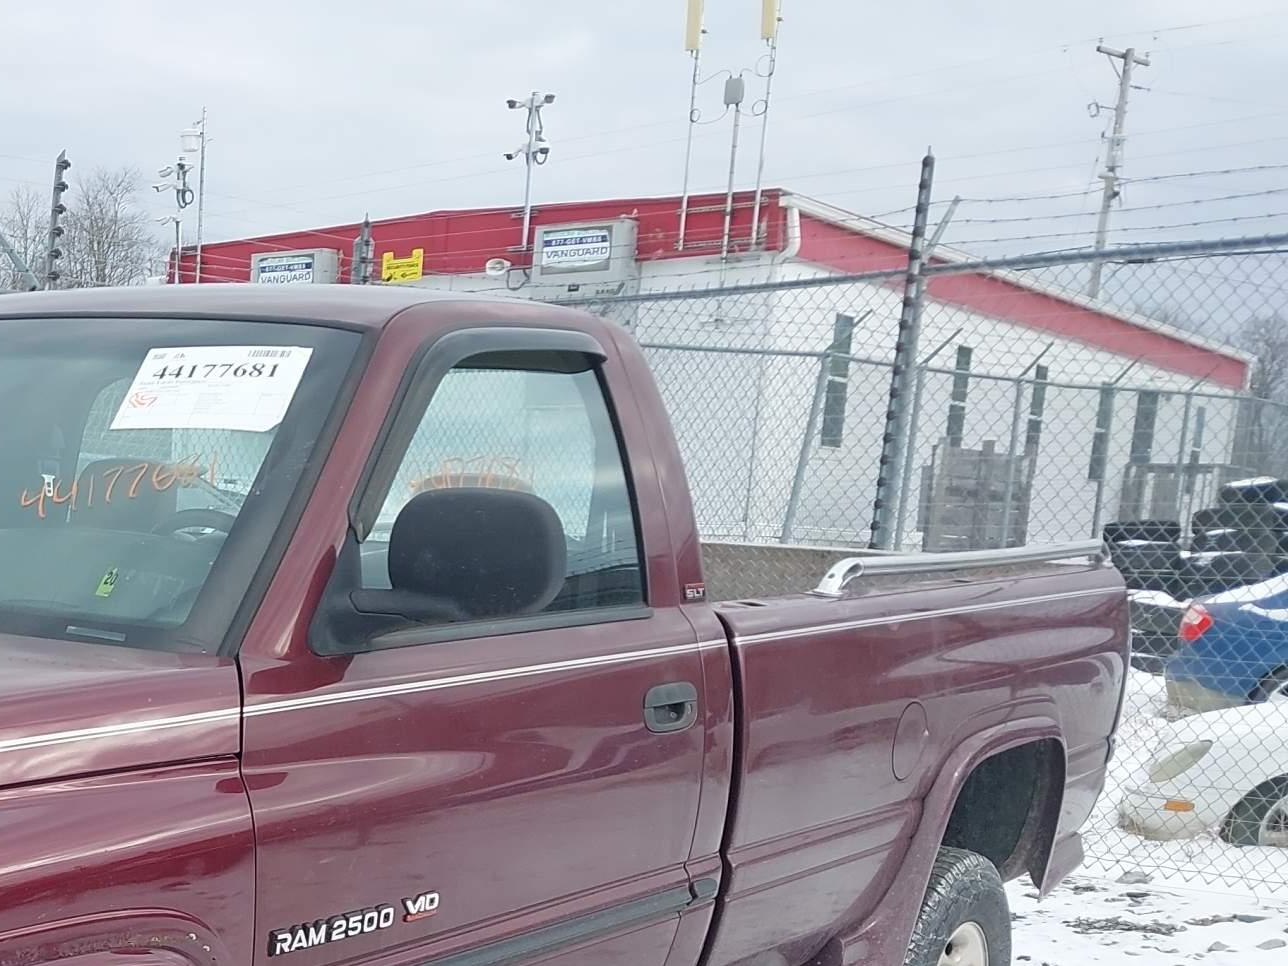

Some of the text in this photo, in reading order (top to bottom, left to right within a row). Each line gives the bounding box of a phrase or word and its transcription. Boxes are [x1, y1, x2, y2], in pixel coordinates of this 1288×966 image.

[546, 247, 608, 259] VANGUARD
[261, 271, 311, 283] VANGUARD
[152, 362, 280, 380] 44177681
[686, 587, 705, 599] SLT
[273, 924, 328, 955] RAM
[330, 906, 395, 941] 2500
